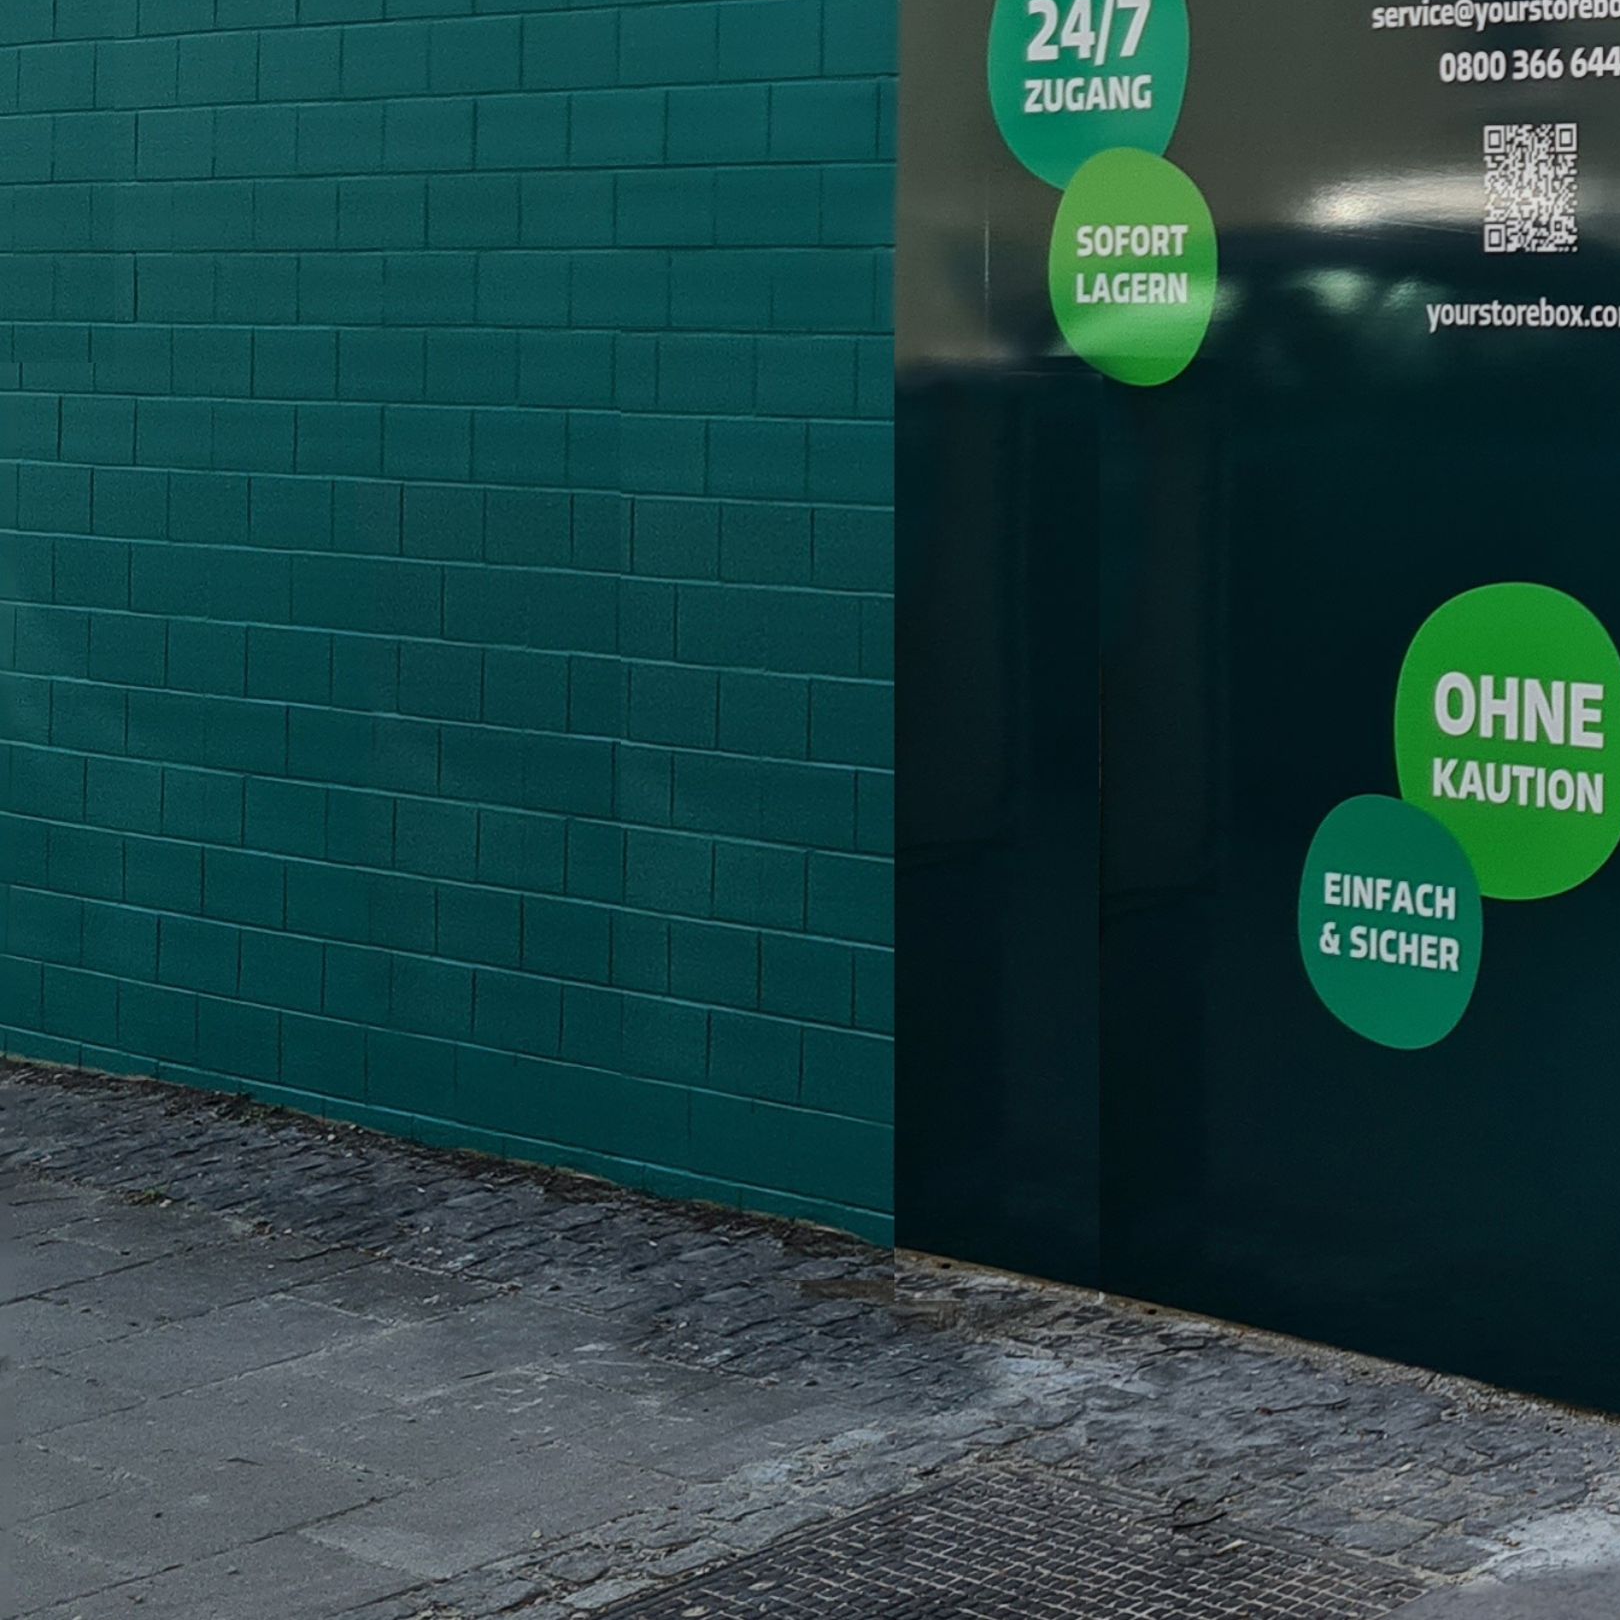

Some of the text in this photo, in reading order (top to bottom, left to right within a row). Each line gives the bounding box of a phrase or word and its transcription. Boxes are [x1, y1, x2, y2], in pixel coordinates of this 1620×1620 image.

[1440, 51, 1505, 82] 0800
[1512, 48, 1563, 80] 366
[1024, 75, 1152, 114] ZUGANG
[1076, 225, 1188, 257] SOFORT
[1075, 273, 1188, 304] LAGERN
[1434, 671, 1604, 749] OHNE
[1433, 758, 1604, 814] KAUTION
[1324, 872, 1456, 920] EINFACH
[1319, 922, 1459, 972] & SICHER
